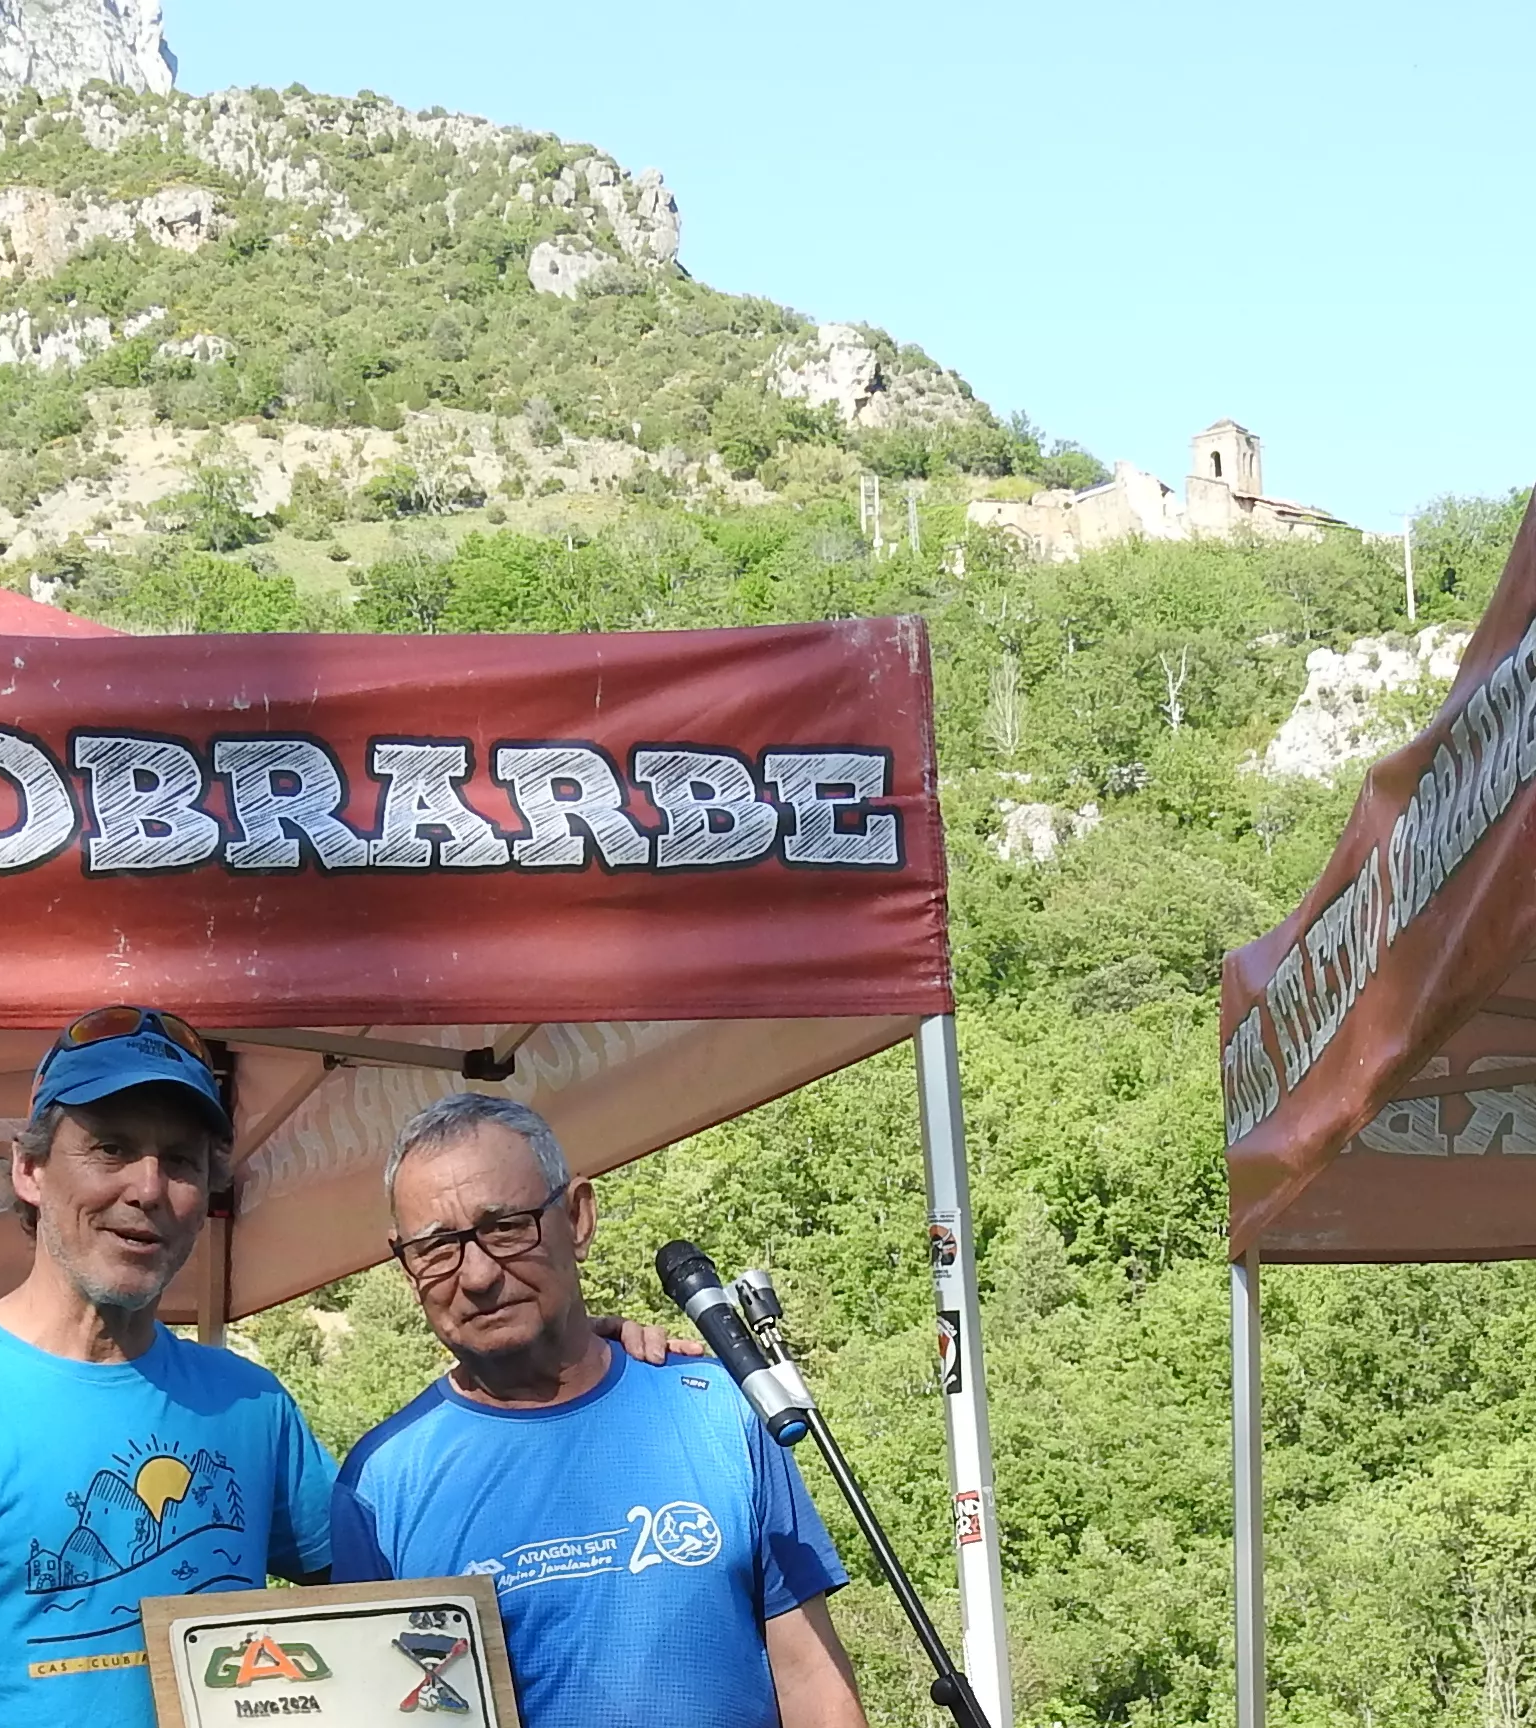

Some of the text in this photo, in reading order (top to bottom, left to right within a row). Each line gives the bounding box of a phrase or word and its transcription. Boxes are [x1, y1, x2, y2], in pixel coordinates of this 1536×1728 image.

[1224, 1005, 1280, 1147] CLUB
[1266, 845, 1384, 1093] ATLETICO
[517, 1537, 618, 1567] ARAGÓN SUR
[497, 1567, 537, 1590] Alpino
[537, 1554, 613, 1581] Javalambre
[36, 1661, 68, 1676] CAS
[91, 1655, 131, 1669] CLUB
